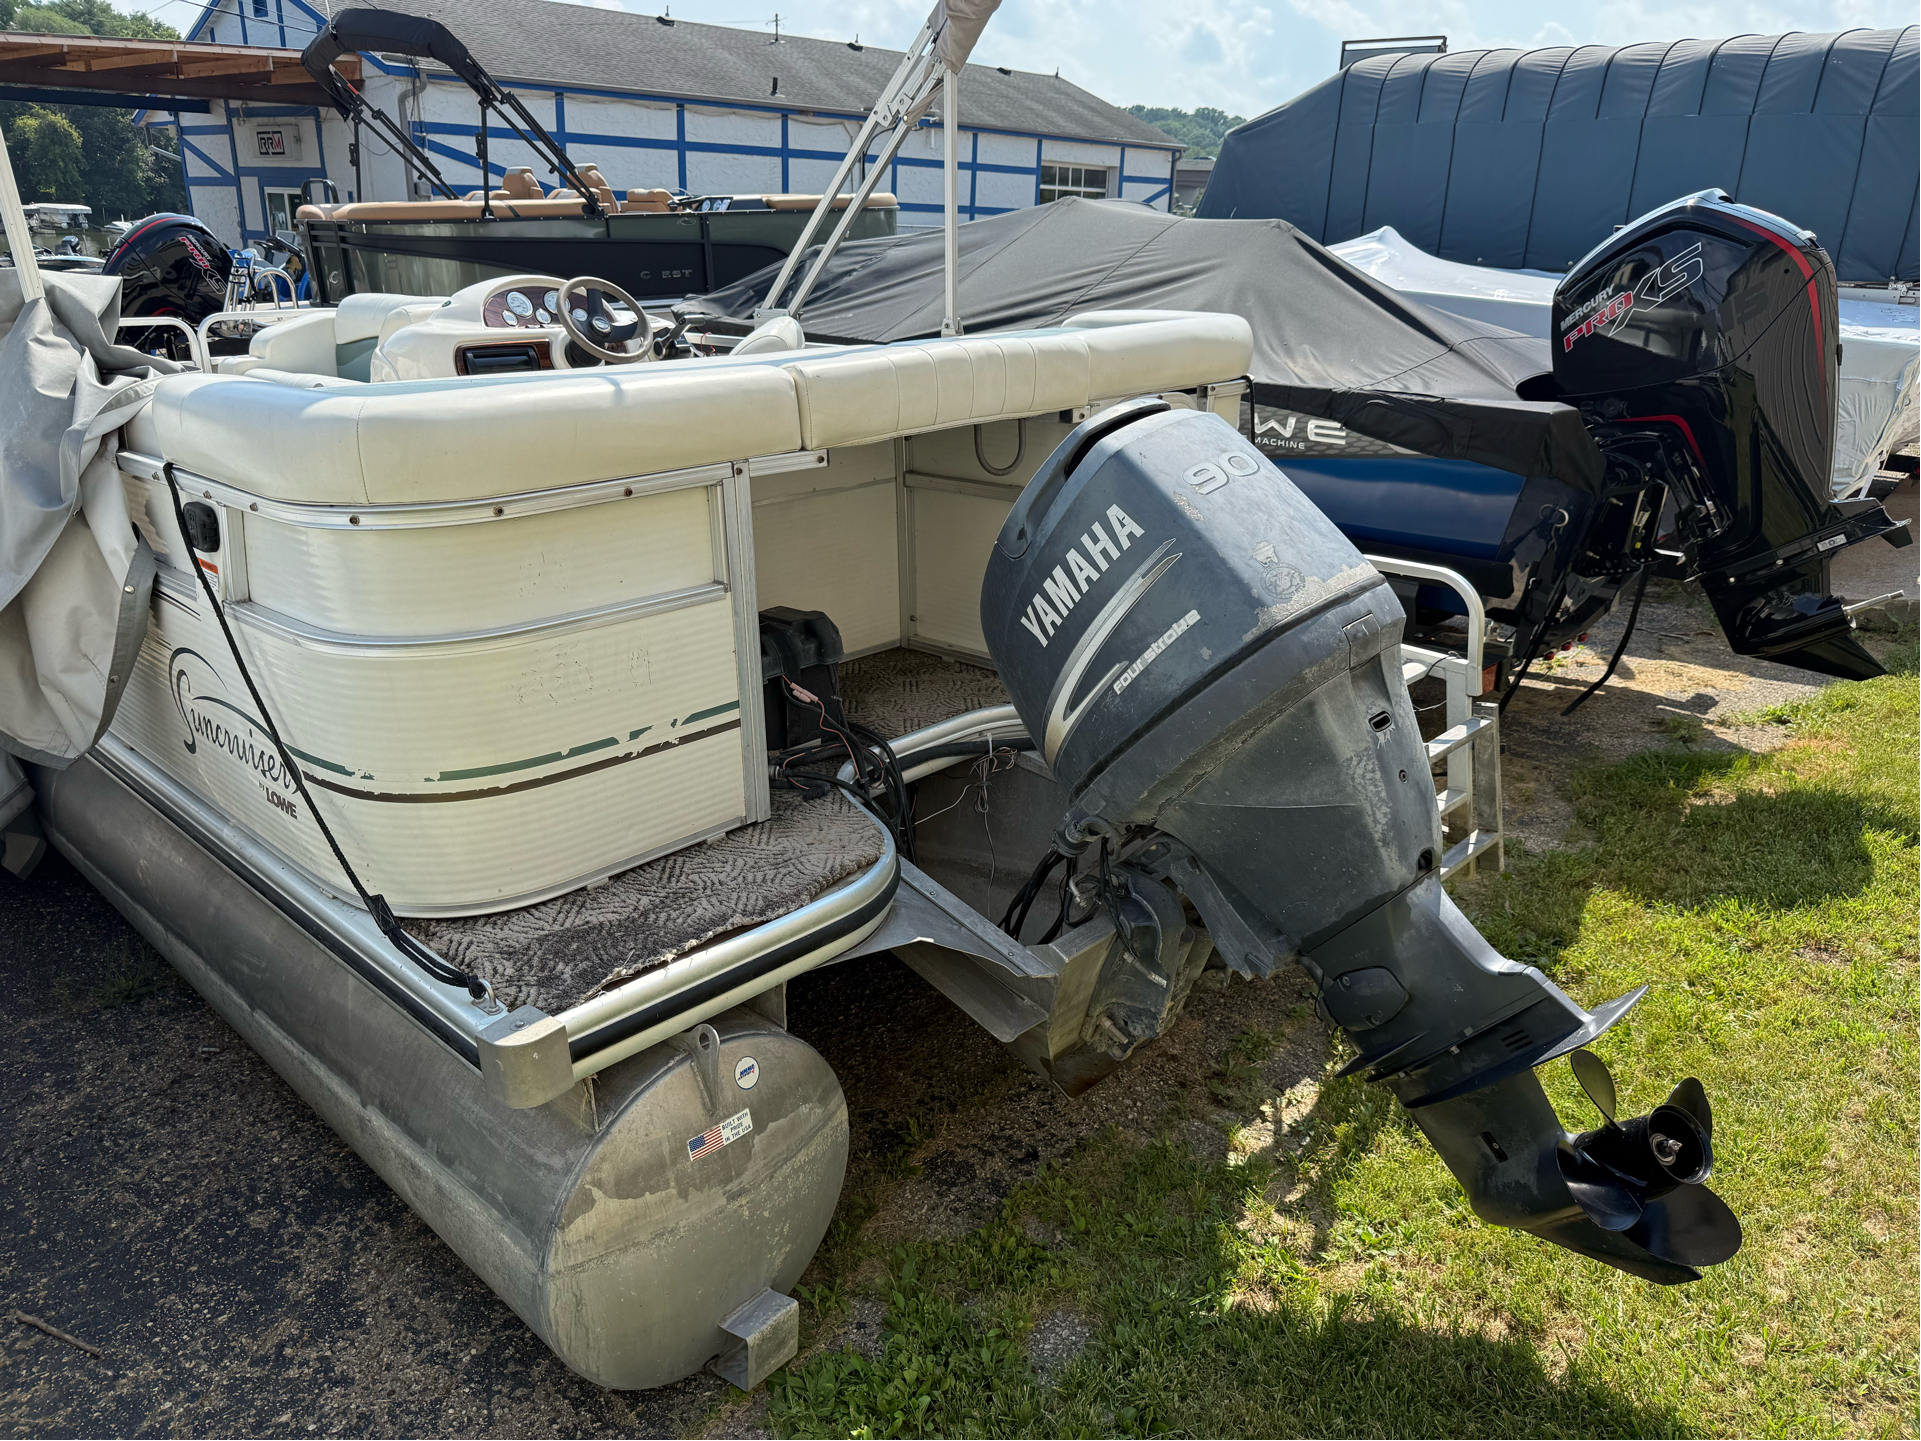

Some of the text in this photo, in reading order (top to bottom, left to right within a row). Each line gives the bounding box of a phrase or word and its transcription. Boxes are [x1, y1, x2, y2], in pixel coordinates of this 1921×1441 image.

[259, 132, 282, 151] RRM
[640, 269, 693, 280] CEST
[1560, 282, 1615, 332] MERCURY
[1564, 290, 1634, 353] PRO
[1254, 437, 1306, 450] MACHINE
[1182, 450, 1261, 496] 90
[1020, 503, 1145, 648] YAMAHA
[174, 668, 292, 790] Suncruiser
[265, 786, 298, 820] LOWE
[721, 1111, 749, 1131] BUILT WITH
[724, 1123, 752, 1143] IN THE USA
[730, 1121, 743, 1133] PRIDE
